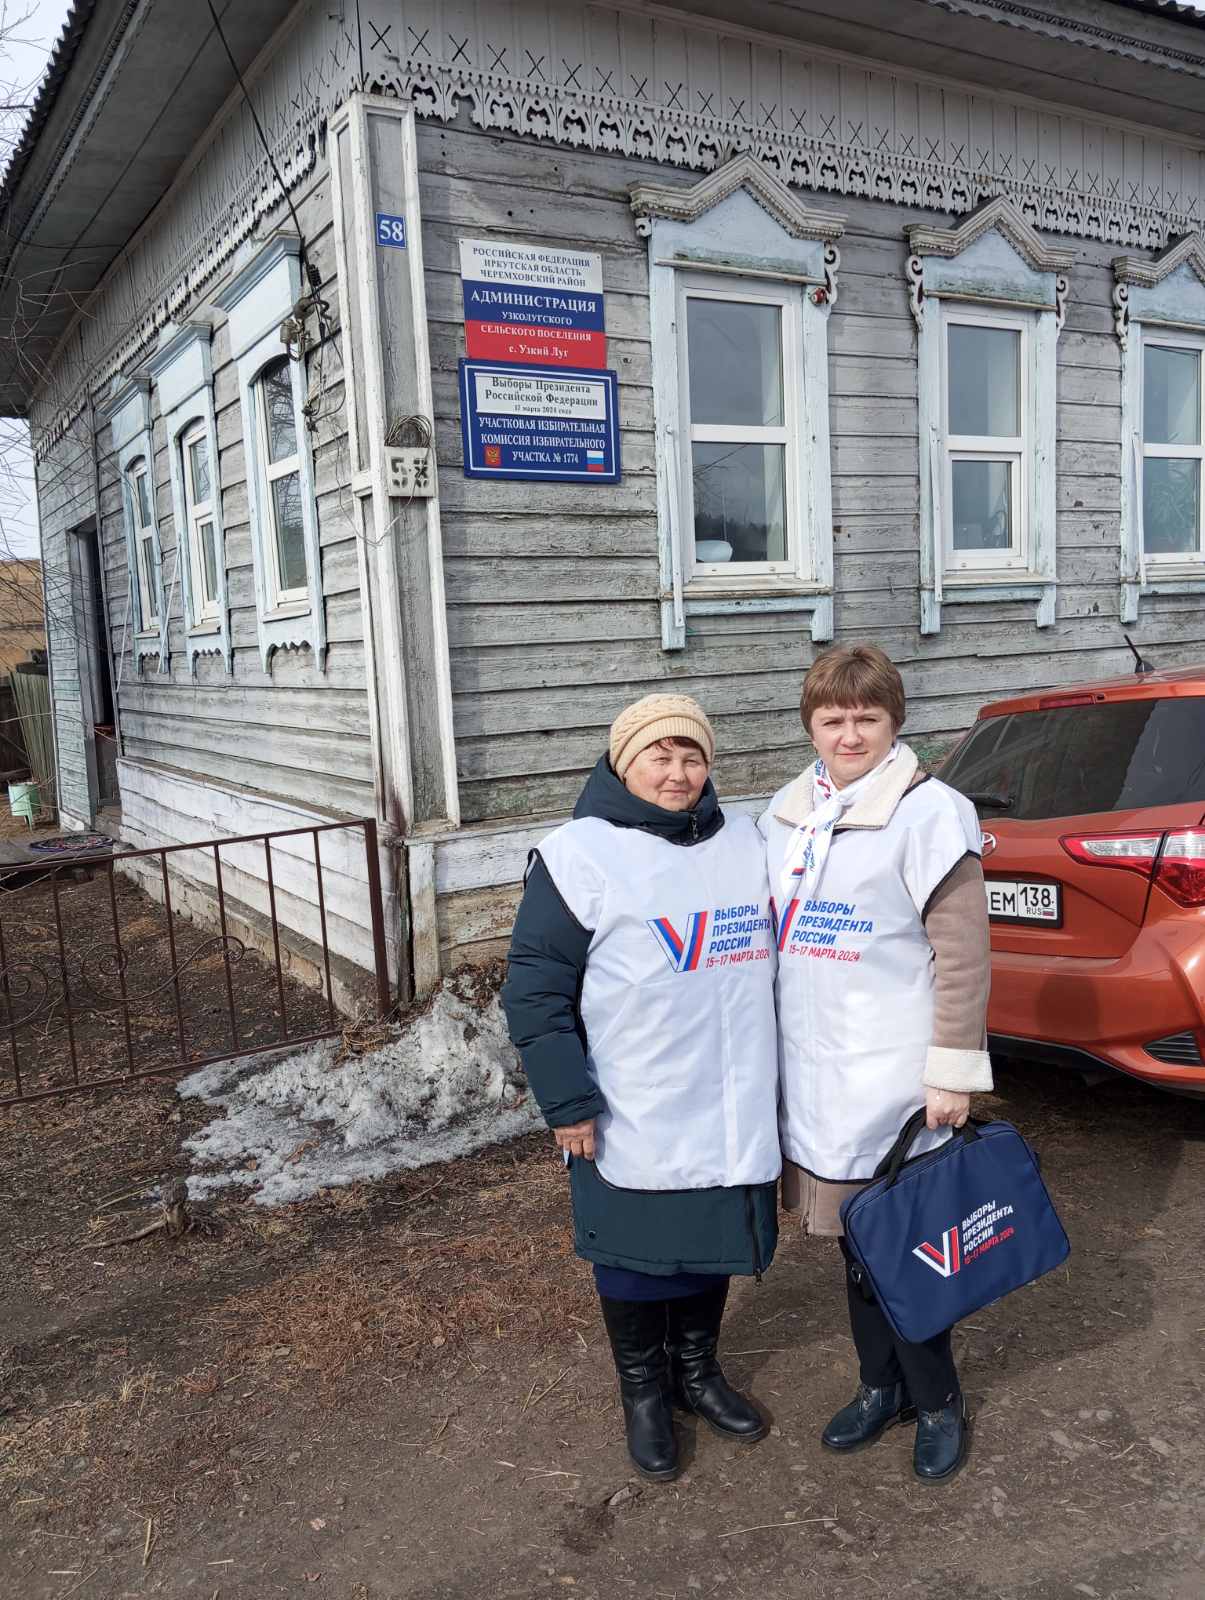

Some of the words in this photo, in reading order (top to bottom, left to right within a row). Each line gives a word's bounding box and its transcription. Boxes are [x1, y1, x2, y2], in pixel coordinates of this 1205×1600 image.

[379, 219, 404, 242] 58
[473, 247, 536, 261] РОССИЙСКАЯ
[537, 254, 590, 267] ФЕДЕРАЦИЯ
[484, 259, 538, 272] ИРКУТСКАЯ
[541, 266, 581, 276] ОБЛАСТЬ
[480, 269, 554, 284] ЧЕРЕМХОВСКИЙ
[557, 276, 586, 287] РАЙОН
[471, 290, 596, 313] АДМИНИСТРАЦИЯ
[502, 311, 573, 326] УЗКОЛУГСКОГО
[480, 324, 535, 337] СЕЛЬСКОГО
[537, 330, 592, 341] ПОСЕЛЕНИЯ
[519, 345, 549, 355] Узкий
[551, 347, 569, 358] Луг
[492, 377, 532, 390] Выборы
[535, 381, 591, 393] Президента
[485, 390, 542, 403] Российской
[545, 395, 598, 407] Федерации
[479, 417, 536, 430] УЧАСТКОВАЯ
[538, 421, 606, 433] ИЗБИРАТЕЛЬНАЯ
[481, 433, 531, 446] КОМИССИЯ
[533, 436, 605, 449] ИЗБИРАТЕЛЬНОГО
[512, 451, 551, 462] УЧАСТКА
[1019, 886, 1051, 907] 138
[714, 904, 759, 922] ВЫБОРЫ
[804, 900, 856, 916] ВЫБОРЫ
[1026, 907, 1042, 915] RUS
[797, 915, 873, 933] ПРЕЗИДЕНТА
[709, 936, 752, 954] РОССИИ
[791, 930, 836, 945] РОССИИ
[729, 950, 754, 965] МАРТА
[808, 947, 837, 959] МАРТА
[837, 951, 861, 962] 2024
[961, 1199, 996, 1231] ВЫБОРЫ
[963, 1204, 1014, 1243] ПРЕЗИДЕНТА
[963, 1226, 994, 1256] РОССИИ
